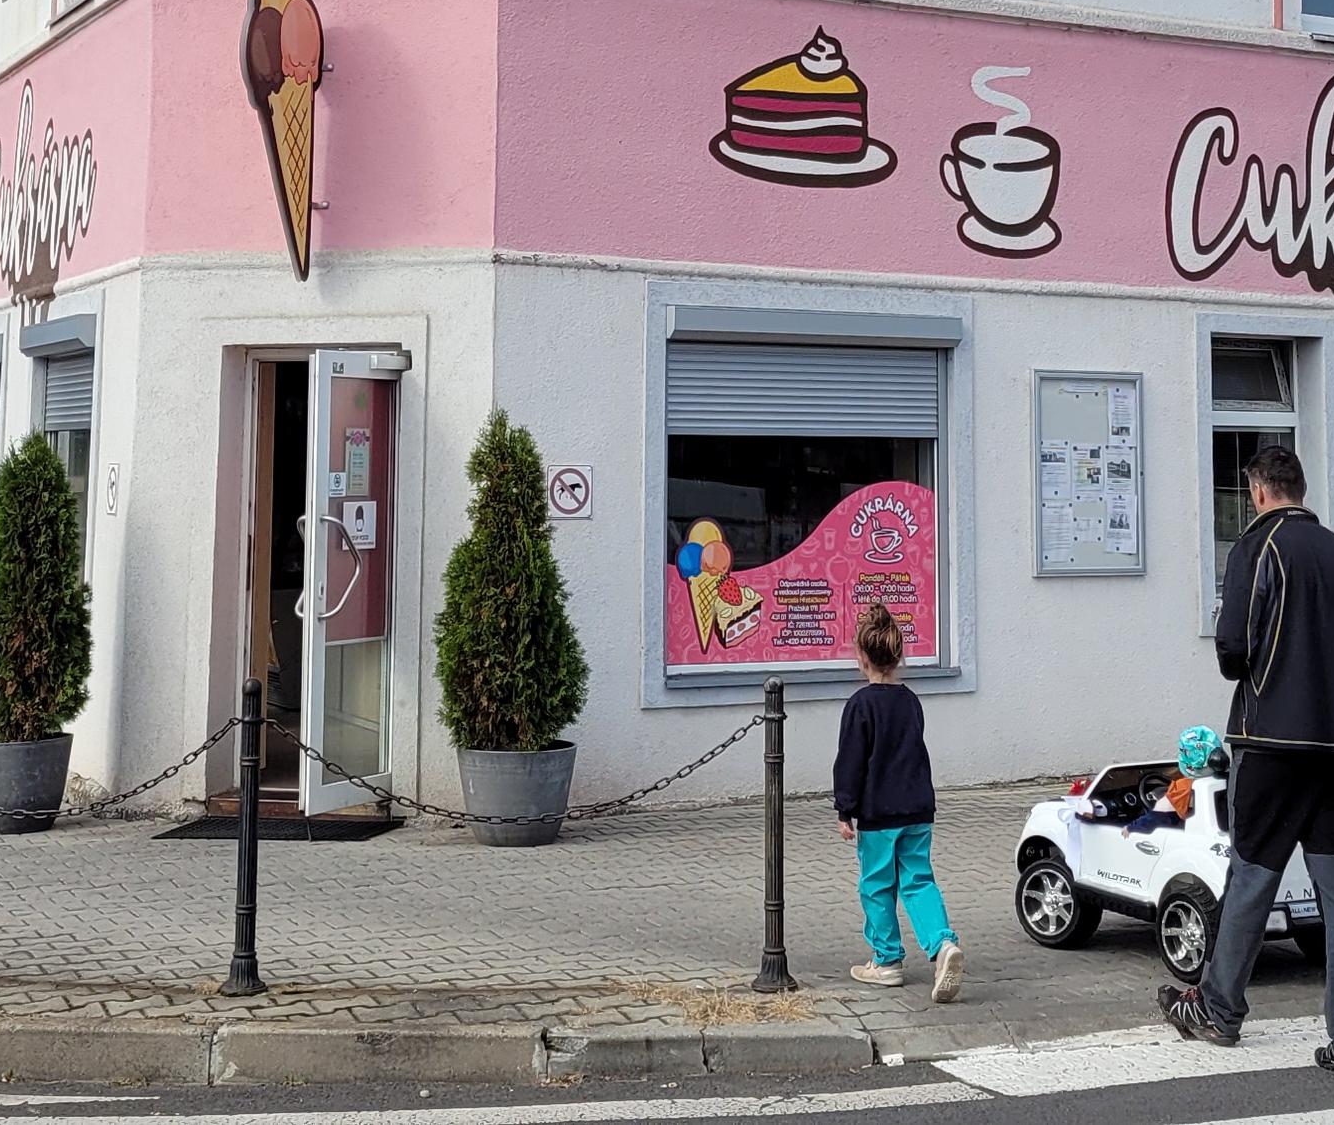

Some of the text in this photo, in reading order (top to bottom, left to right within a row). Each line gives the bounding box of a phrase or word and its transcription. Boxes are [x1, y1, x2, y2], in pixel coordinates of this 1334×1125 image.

[851, 494, 919, 537] CUKRÁRNA
[890, 572, 910, 581] Pátek
[897, 584, 915, 592] hodin
